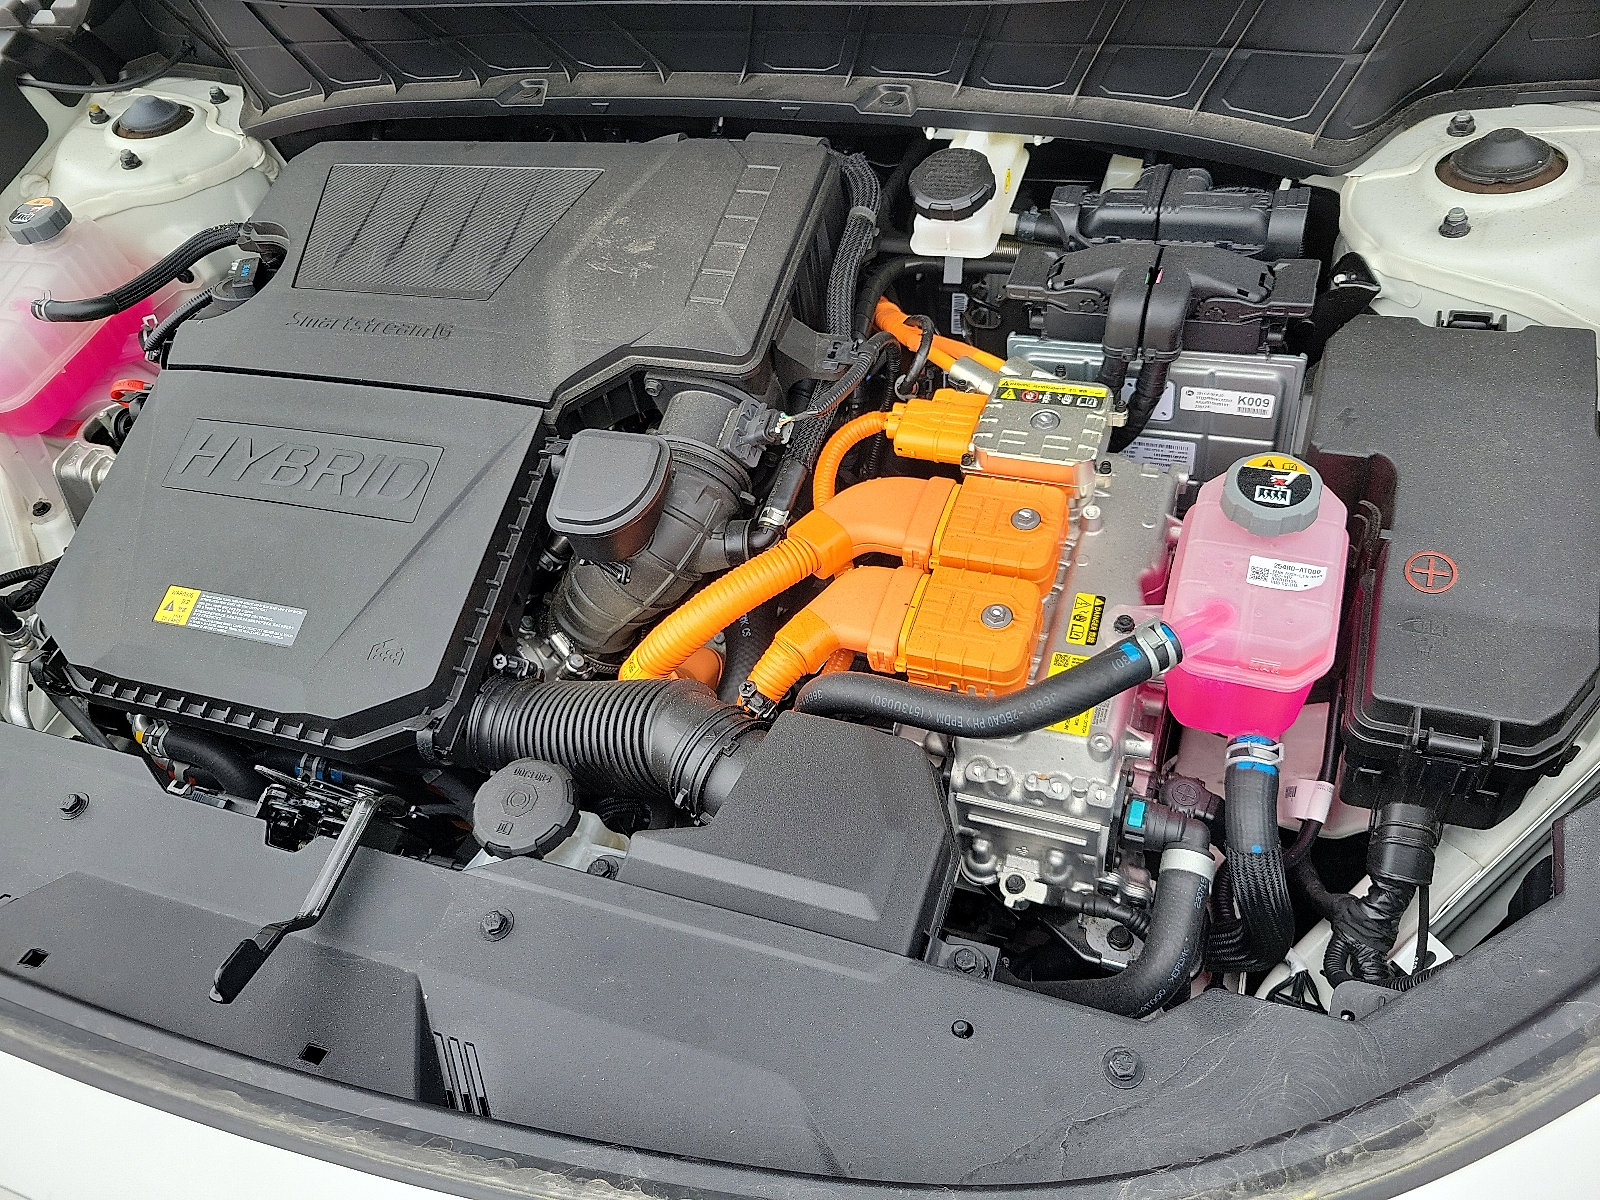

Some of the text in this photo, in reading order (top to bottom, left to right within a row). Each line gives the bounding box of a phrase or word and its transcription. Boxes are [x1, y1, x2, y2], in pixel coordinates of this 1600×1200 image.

[1237, 395, 1271, 409] K009
[178, 433, 430, 501] HYBRID
[935, 711, 964, 728] EPDM
